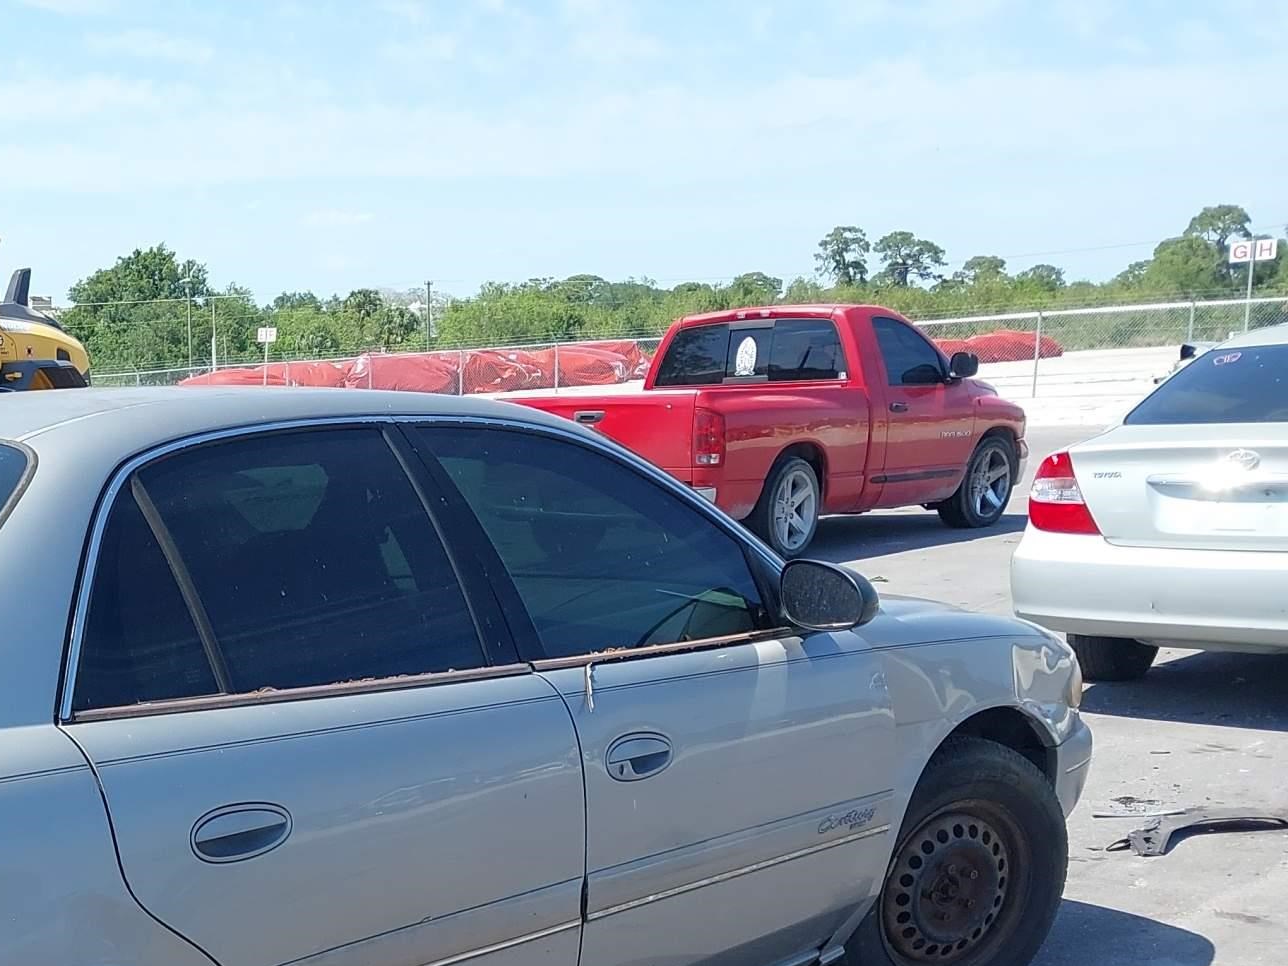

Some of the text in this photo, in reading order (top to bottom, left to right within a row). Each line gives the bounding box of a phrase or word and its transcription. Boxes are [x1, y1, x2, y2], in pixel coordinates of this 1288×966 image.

[1233, 241, 1273, 259] G H
[1093, 471, 1122, 479] TOYOTA
